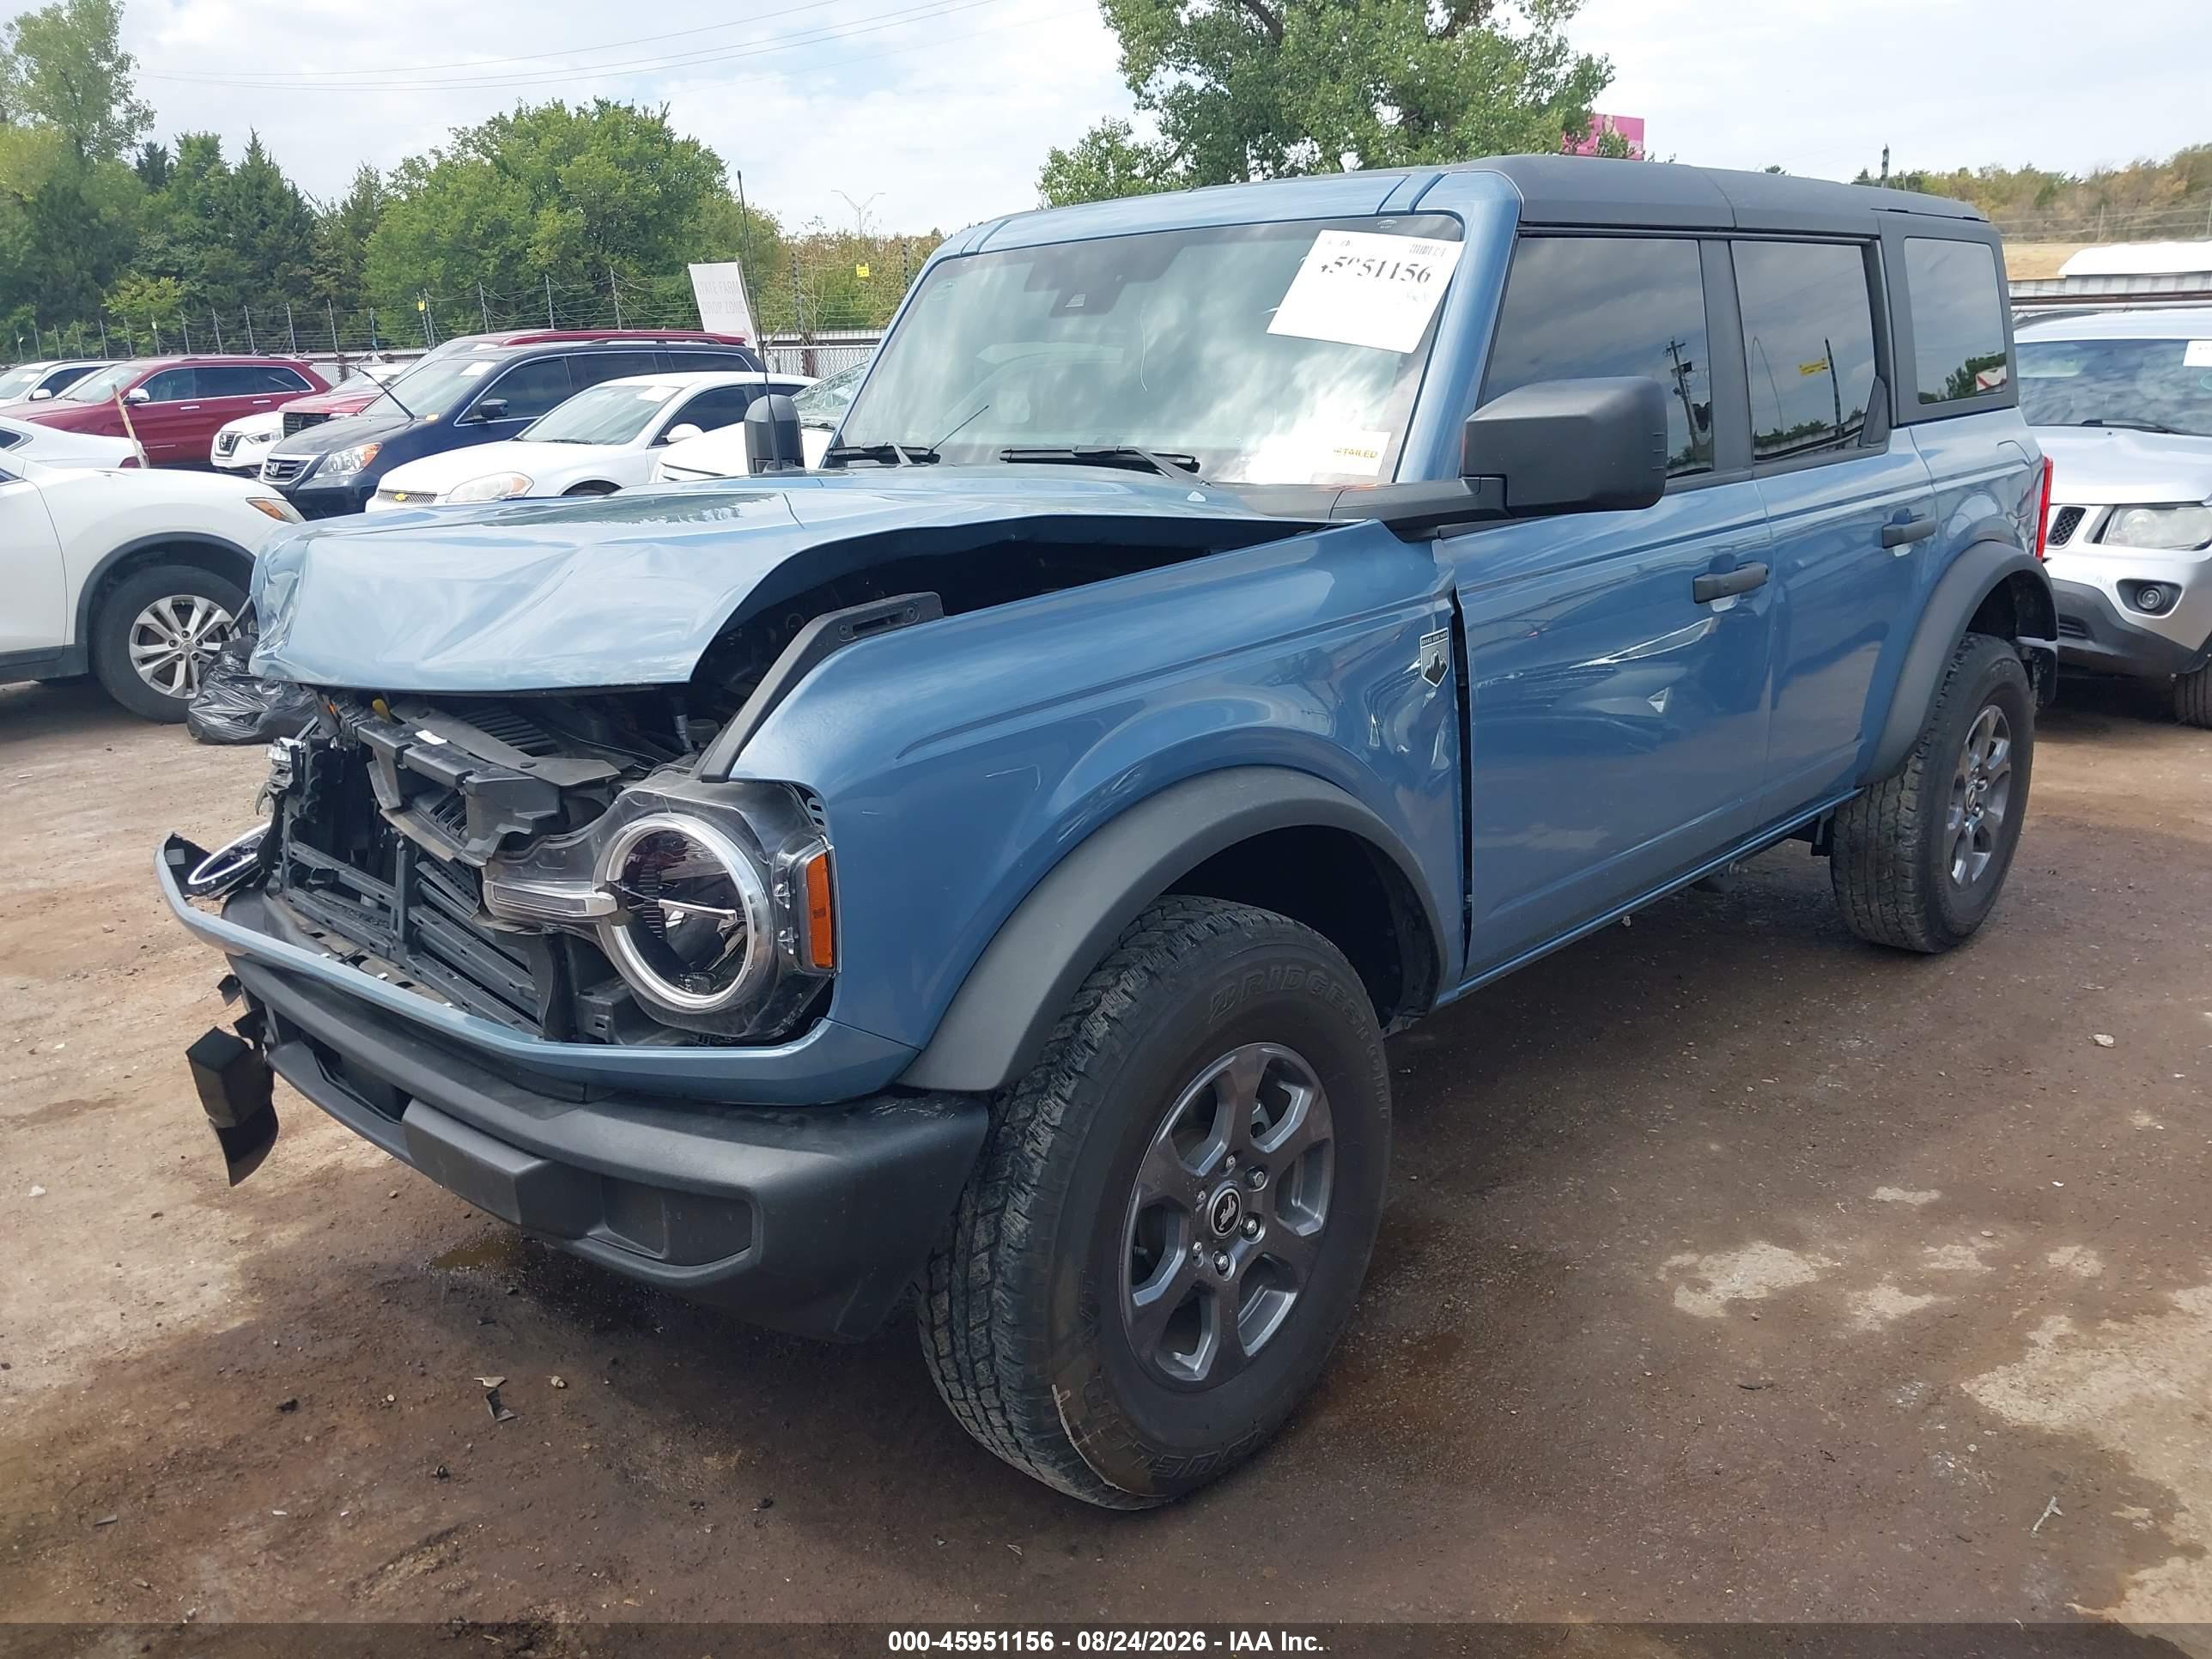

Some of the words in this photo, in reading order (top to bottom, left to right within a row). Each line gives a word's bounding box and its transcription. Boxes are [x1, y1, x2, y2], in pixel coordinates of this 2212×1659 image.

[696, 282, 719, 295] STATE
[719, 282, 741, 295] FARM
[702, 301, 722, 315] DROP
[725, 301, 745, 315] ZONE
[1333, 447, 1378, 458] TAILED
[1421, 637, 1433, 646] BIG
[1433, 632, 1448, 641] BEND
